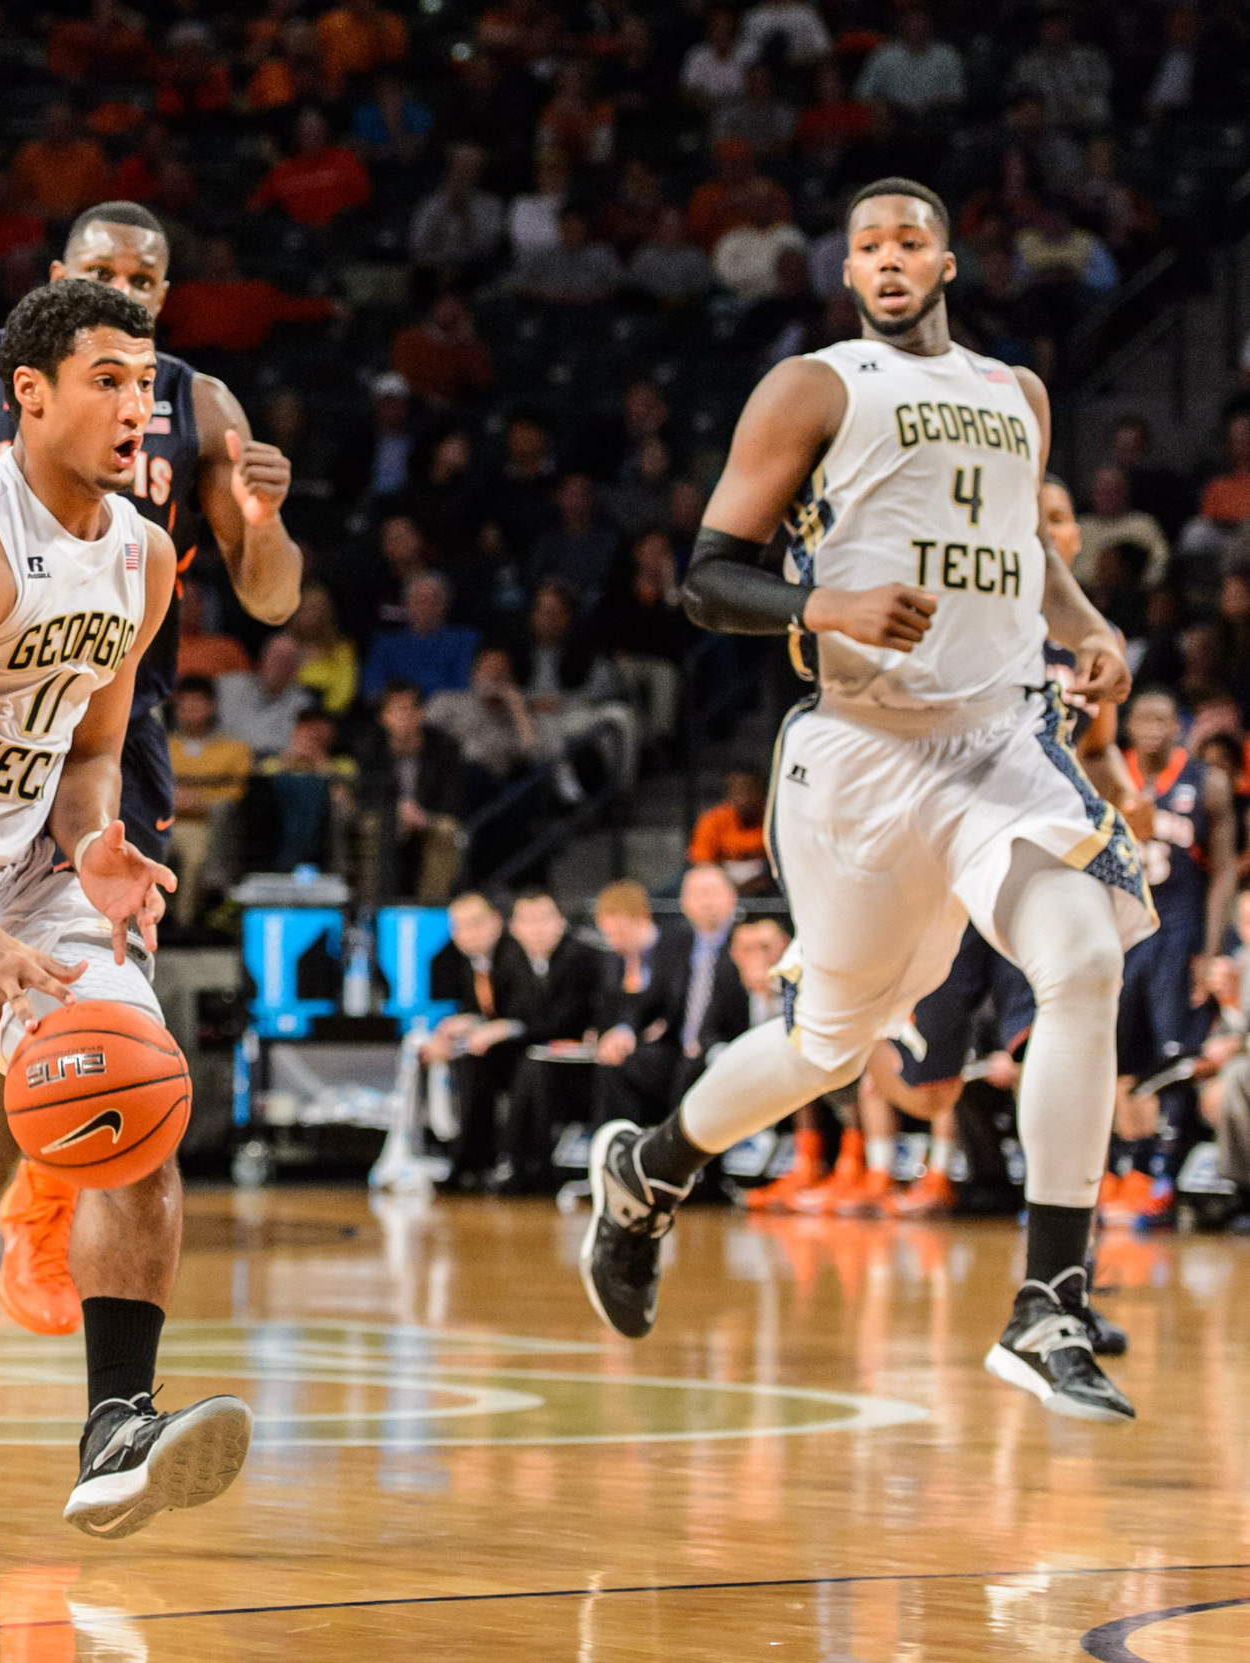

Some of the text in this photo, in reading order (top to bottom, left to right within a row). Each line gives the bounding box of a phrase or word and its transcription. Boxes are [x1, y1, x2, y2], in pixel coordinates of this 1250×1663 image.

[895, 401, 1031, 461] GEORGIA
[953, 464, 984, 528] 4
[910, 539, 1023, 600] TECH
[23, 671, 81, 736] 11
[26, 1052, 107, 1089] ELITE
